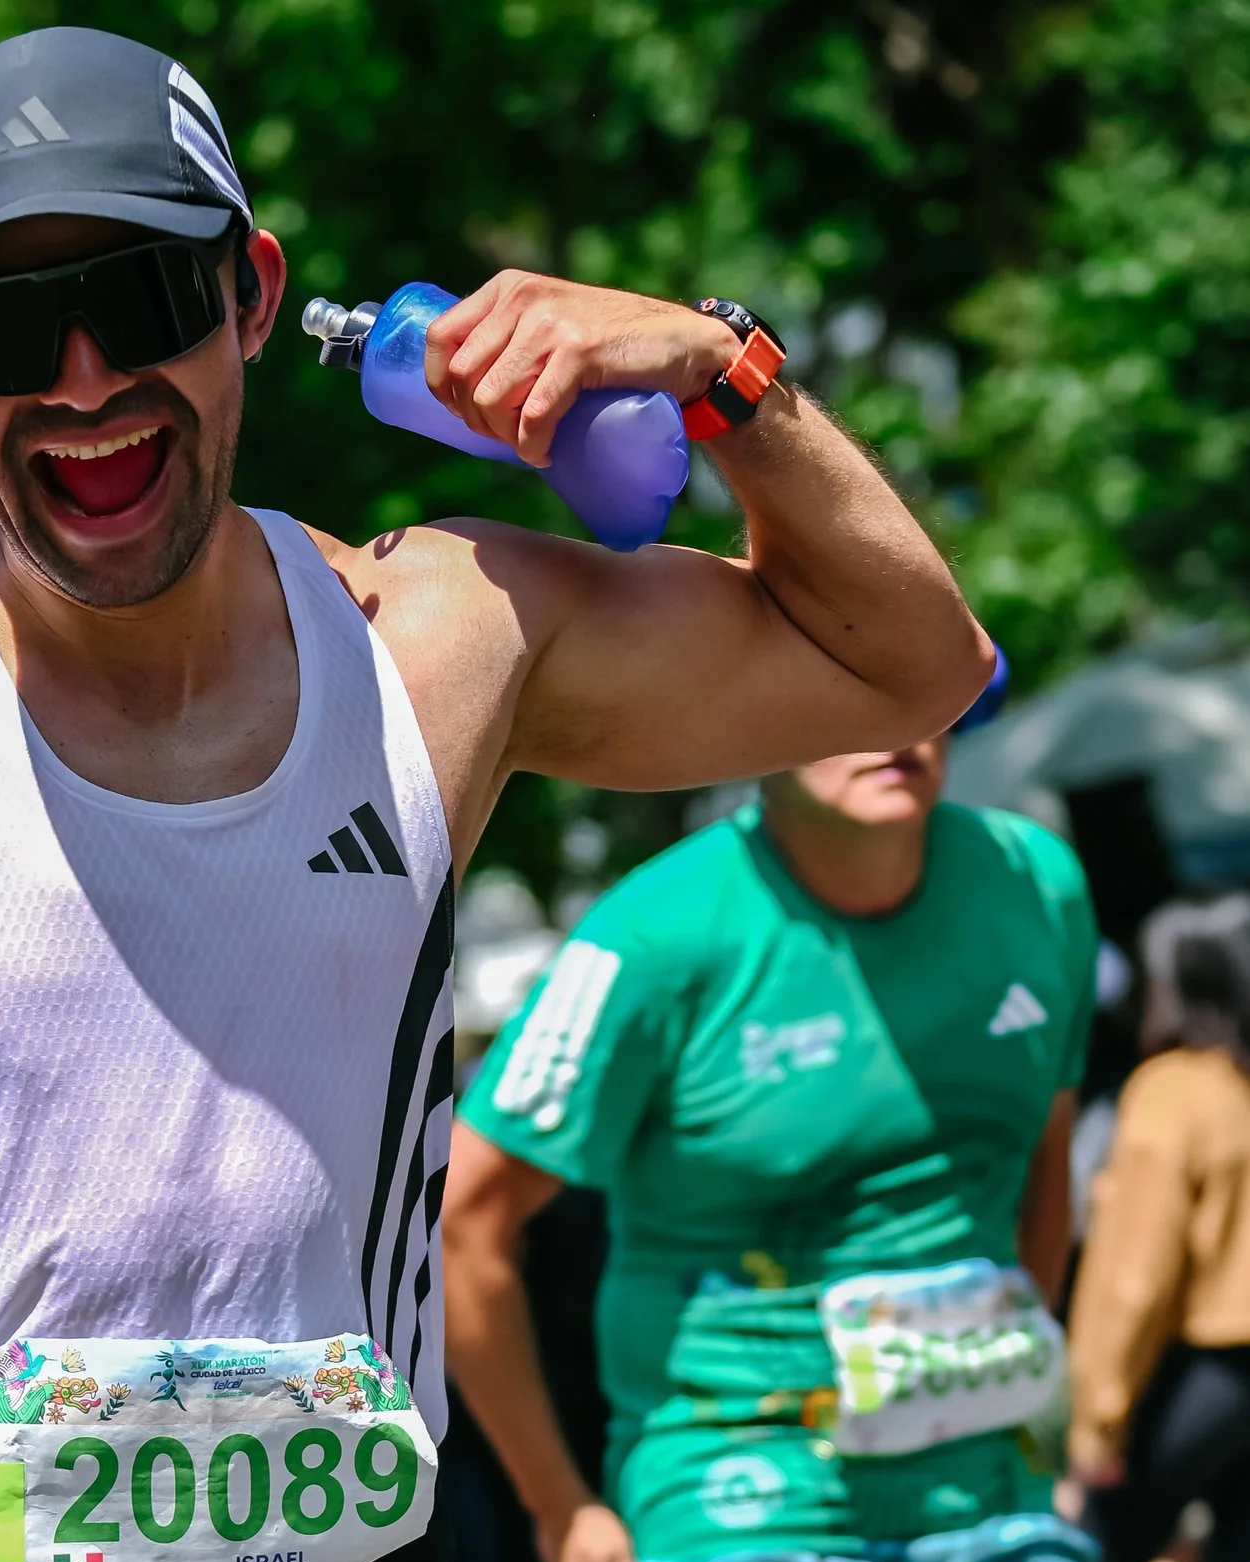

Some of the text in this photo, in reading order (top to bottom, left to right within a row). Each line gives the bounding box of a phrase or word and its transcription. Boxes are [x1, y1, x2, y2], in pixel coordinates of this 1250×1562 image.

[216, 1355, 266, 1369] MARATÓN
[190, 1367, 266, 1379] CIUDAD DE MÉXICO
[213, 1379, 244, 1391] telcel
[53, 1422, 419, 1544] 20089
